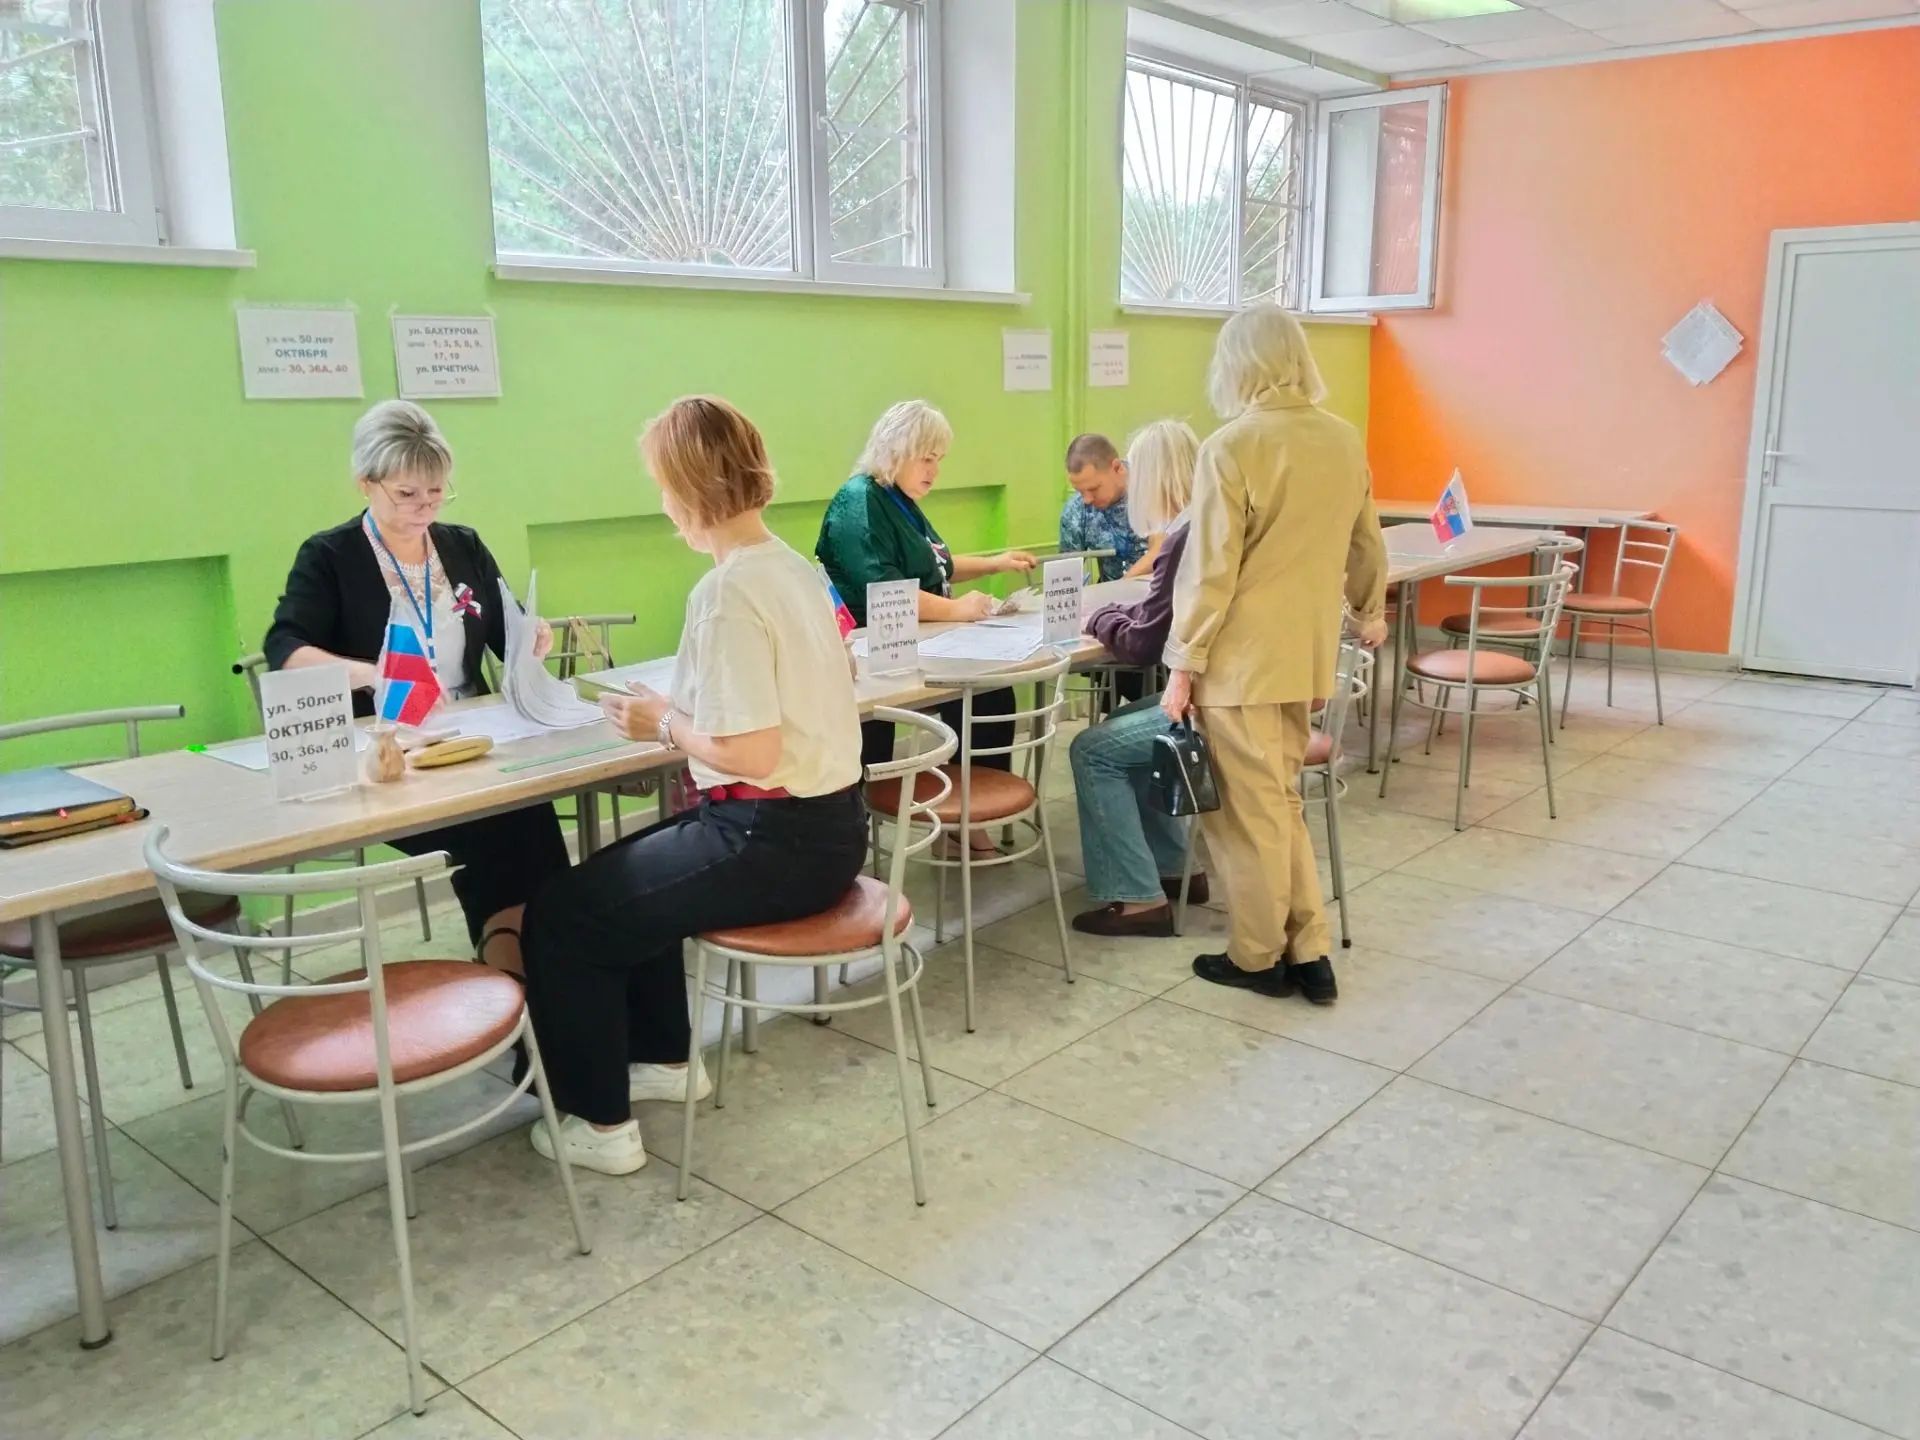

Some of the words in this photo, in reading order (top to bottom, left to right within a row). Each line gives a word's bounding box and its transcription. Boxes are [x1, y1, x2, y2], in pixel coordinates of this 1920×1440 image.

[408, 327, 422, 336] ул.
[424, 326, 479, 335] БАХТУРОВА
[298, 334, 311, 344] 50
[315, 336, 334, 344] лет
[274, 348, 328, 359] ОКТЯБРЯ
[434, 352, 448, 361] 17,
[288, 363, 306, 375] 30,
[335, 363, 348, 373] 40
[416, 366, 430, 375] ул.
[431, 363, 480, 373] ВУЧЕТИЧА
[1045, 586, 1079, 598] ГОЛУБЕВА
[871, 598, 911, 609] БАХТУРОВА
[881, 638, 918, 650] ВУЧЕТИЧА
[266, 703, 292, 719] ул.
[296, 692, 344, 711] 50лет
[268, 713, 347, 740] ОКТЯБРЯ
[271, 749, 294, 764] 30,
[297, 743, 328, 758] 36а,
[332, 736, 349, 750] 40
